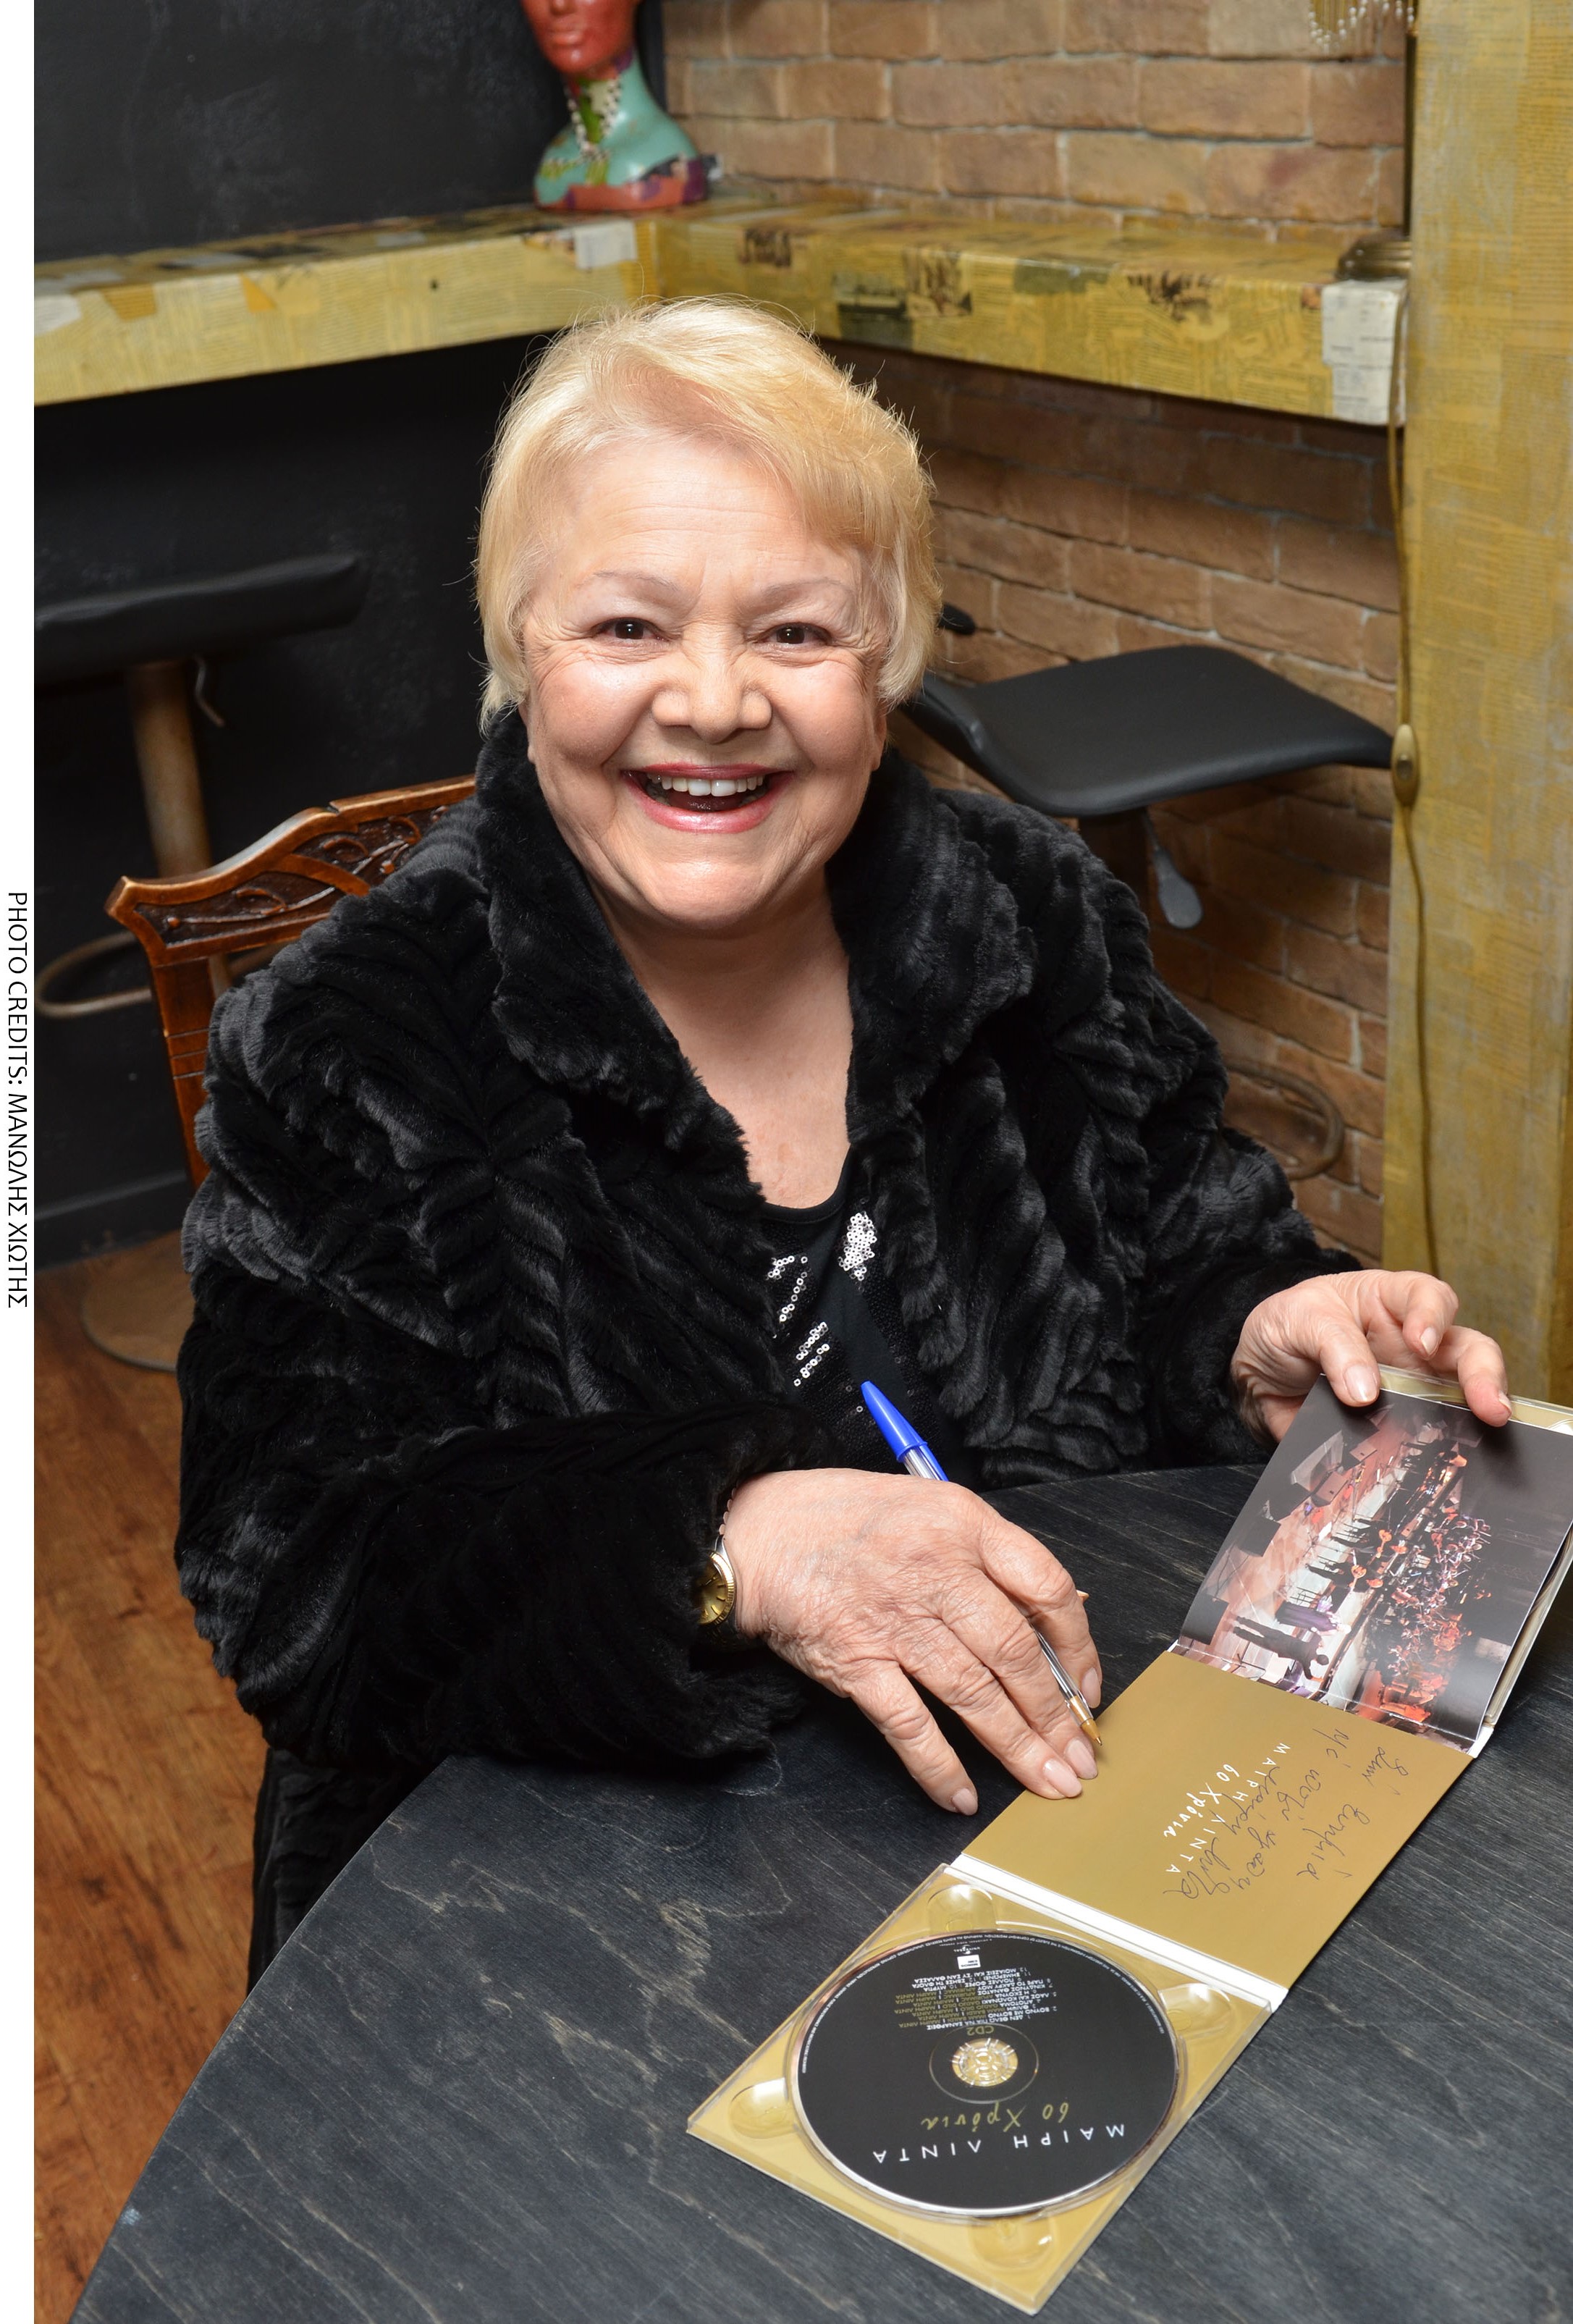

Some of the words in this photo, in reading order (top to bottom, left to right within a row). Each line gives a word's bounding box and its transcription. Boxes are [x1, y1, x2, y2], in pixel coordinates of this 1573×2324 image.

[1216, 1764, 1240, 1782] 60
[1232, 1742, 1291, 1802] ΜΑΙΡΗ
[1163, 1782, 1223, 1838] Χρόνια
[1165, 1813, 1226, 1874] ΛΙΝΤΑ
[966, 2025, 994, 2037] CD2
[921, 2101, 1025, 2133] Χρόνια
[1042, 2102, 1069, 2123] 60
[1013, 2124, 1124, 2148] ΜΑΙΡΗ
[873, 2139, 982, 2164] ΛΙΝΤΑ
